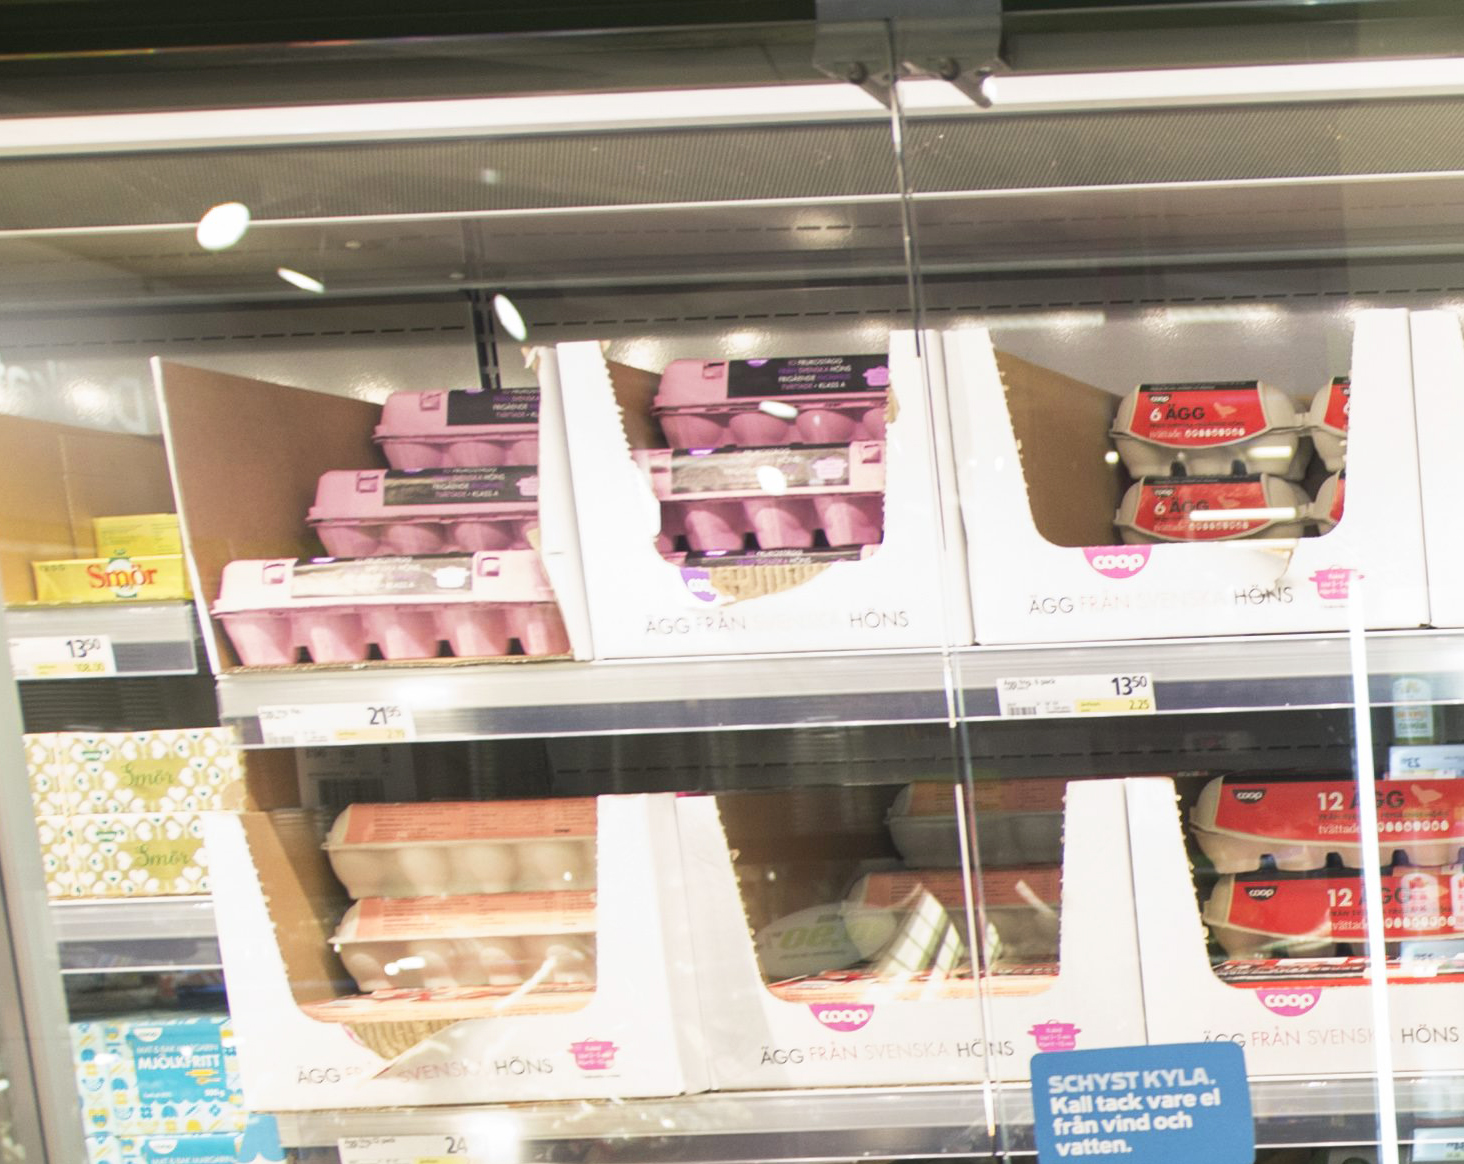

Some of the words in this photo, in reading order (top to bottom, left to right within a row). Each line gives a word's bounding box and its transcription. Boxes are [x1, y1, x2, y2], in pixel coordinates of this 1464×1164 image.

[1165, 404, 1205, 420] ÄGG
[1092, 554, 1145, 571] coop
[87, 563, 157, 589] Smör
[1029, 594, 1074, 614] ÄGG
[1235, 584, 1294, 605] HÖNS
[850, 609, 910, 629] HÖNS
[1317, 791, 1344, 811] 12
[1327, 888, 1353, 907] 12
[1264, 992, 1315, 1010] coop
[818, 1009, 868, 1025] coop
[1252, 1026, 1300, 1047] FRÅN
[1401, 1025, 1459, 1044] HÖNS
[137, 1052, 220, 1070] MJÖLKFRITT
[761, 1043, 804, 1065] ÄGG
[808, 1041, 857, 1061] FRÅN
[495, 1055, 554, 1076] HÖNS
[1048, 1071, 1139, 1094] SCHYST
[1143, 1067, 1216, 1089] KYLA.
[1050, 1095, 1093, 1115] Kall
[1095, 1092, 1144, 1113] tack
[1146, 1092, 1196, 1109] vare
[1200, 1088, 1221, 1106] el
[1053, 1115, 1099, 1136] från
[1101, 1113, 1150, 1133] vind
[1153, 1111, 1193, 1130] och
[1055, 1138, 1132, 1157] vatten.
